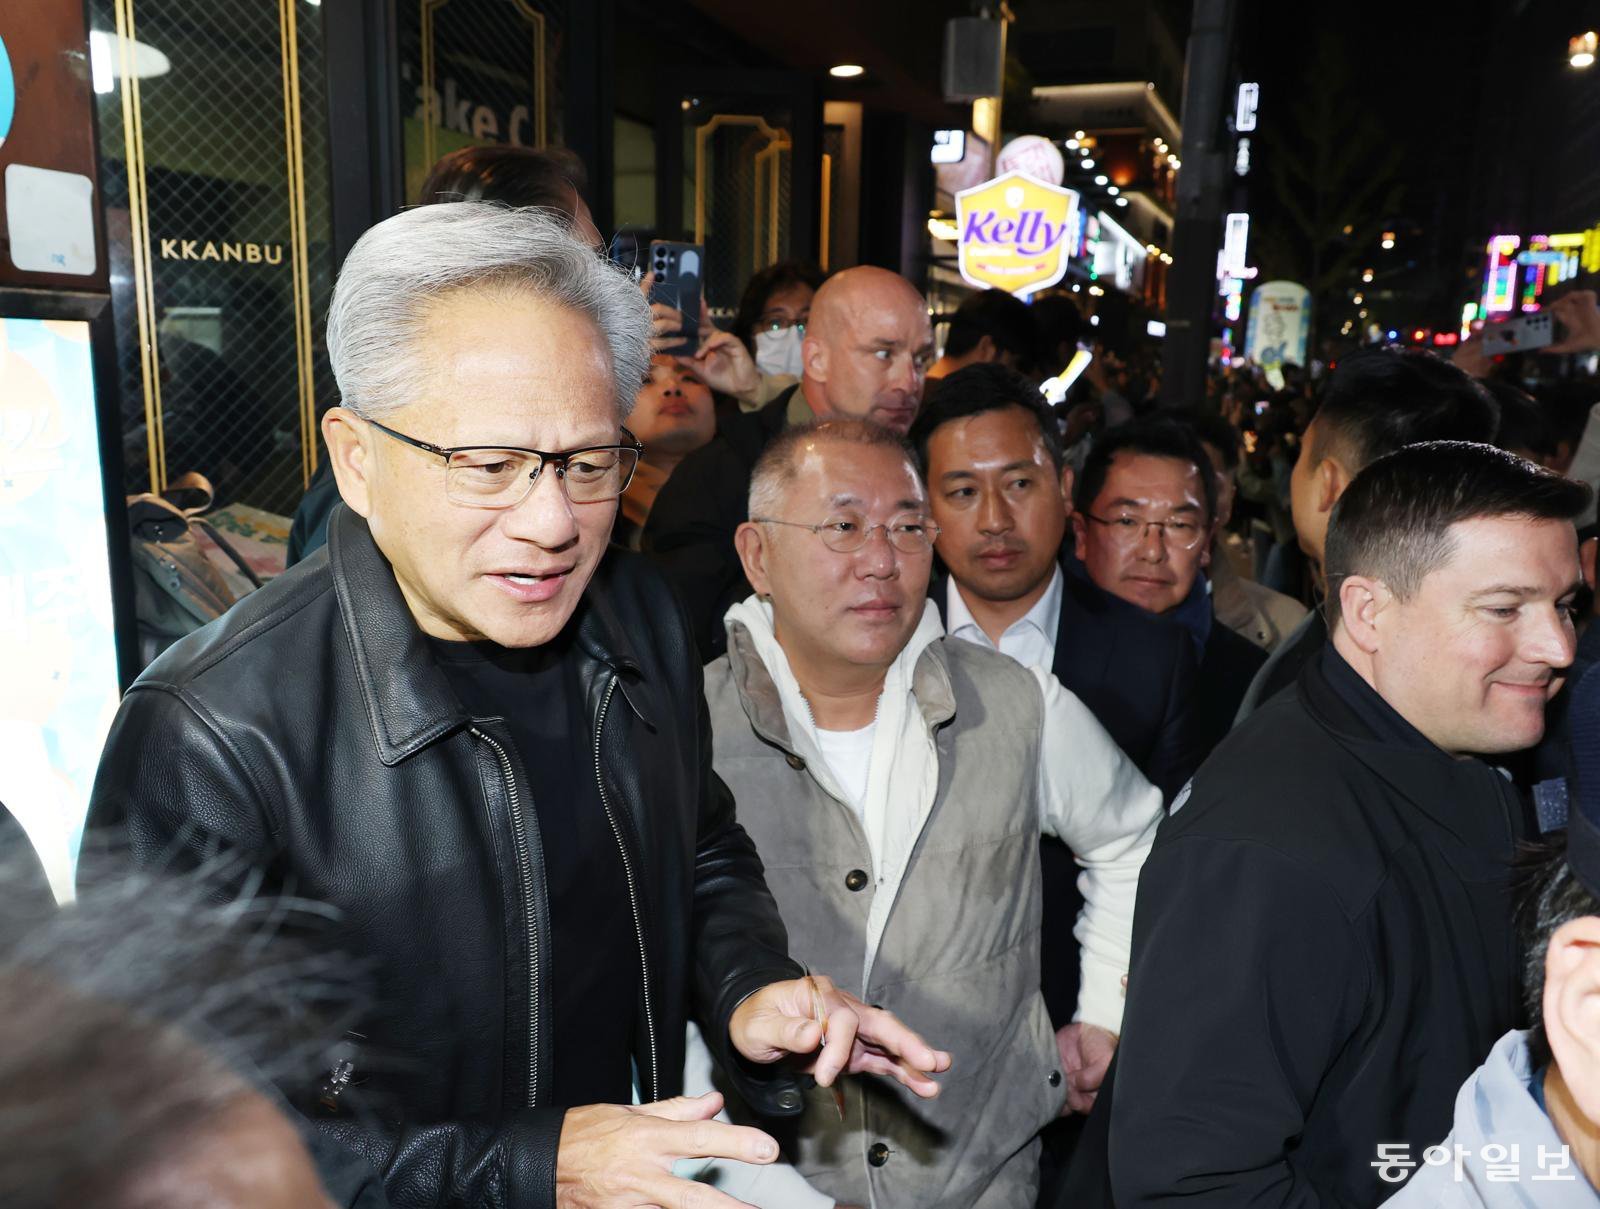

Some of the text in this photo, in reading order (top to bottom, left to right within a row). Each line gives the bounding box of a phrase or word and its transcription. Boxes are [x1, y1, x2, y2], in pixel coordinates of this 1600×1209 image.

[404, 75, 499, 143] ake
[160, 238, 282, 265] KKANBU
[963, 211, 1066, 256] Kelly
